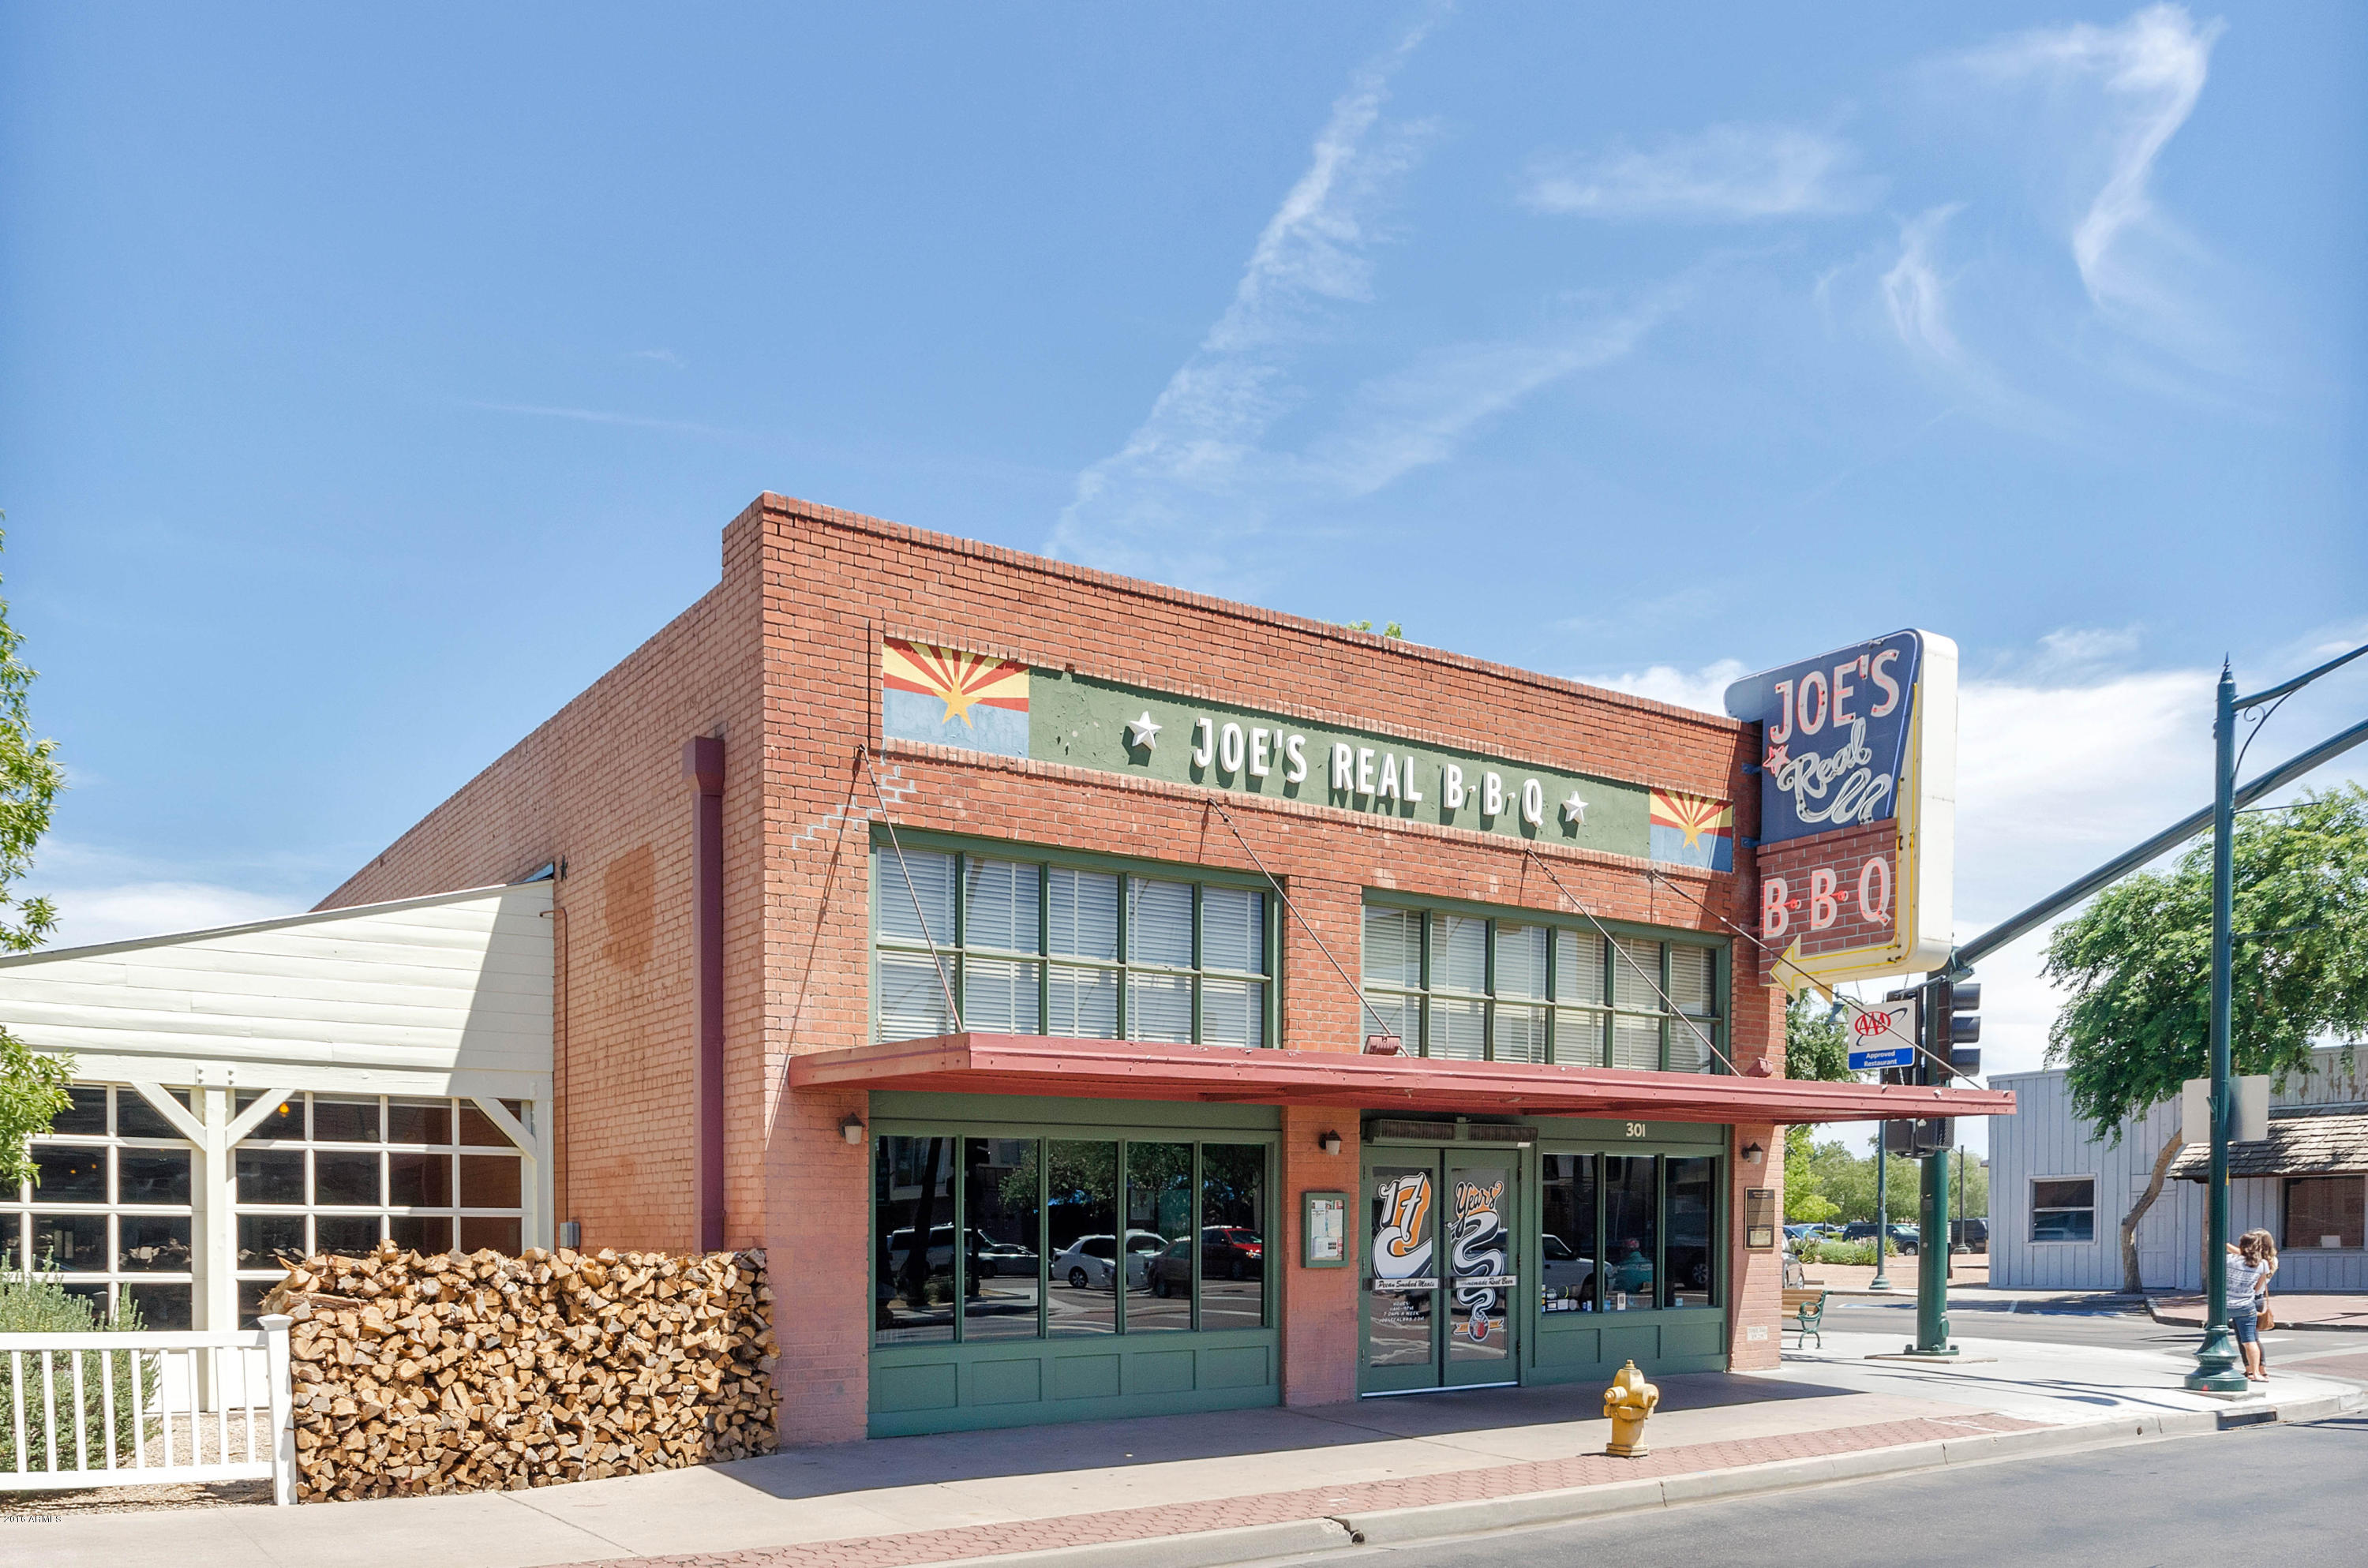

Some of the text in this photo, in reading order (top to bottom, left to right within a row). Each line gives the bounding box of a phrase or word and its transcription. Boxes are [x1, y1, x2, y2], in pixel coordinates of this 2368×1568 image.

[1770, 649, 1900, 744] JOE'S
[1193, 717, 1306, 783] JOE'S
[1332, 742, 1423, 803] REAL
[1777, 717, 1873, 821] Real
[1857, 1011, 1887, 1035] AAA
[1866, 1050, 1895, 1059] Approved
[1626, 1122, 1646, 1137] 301
[1379, 1173, 1426, 1243] 17
[1456, 1181, 1504, 1238] Years
